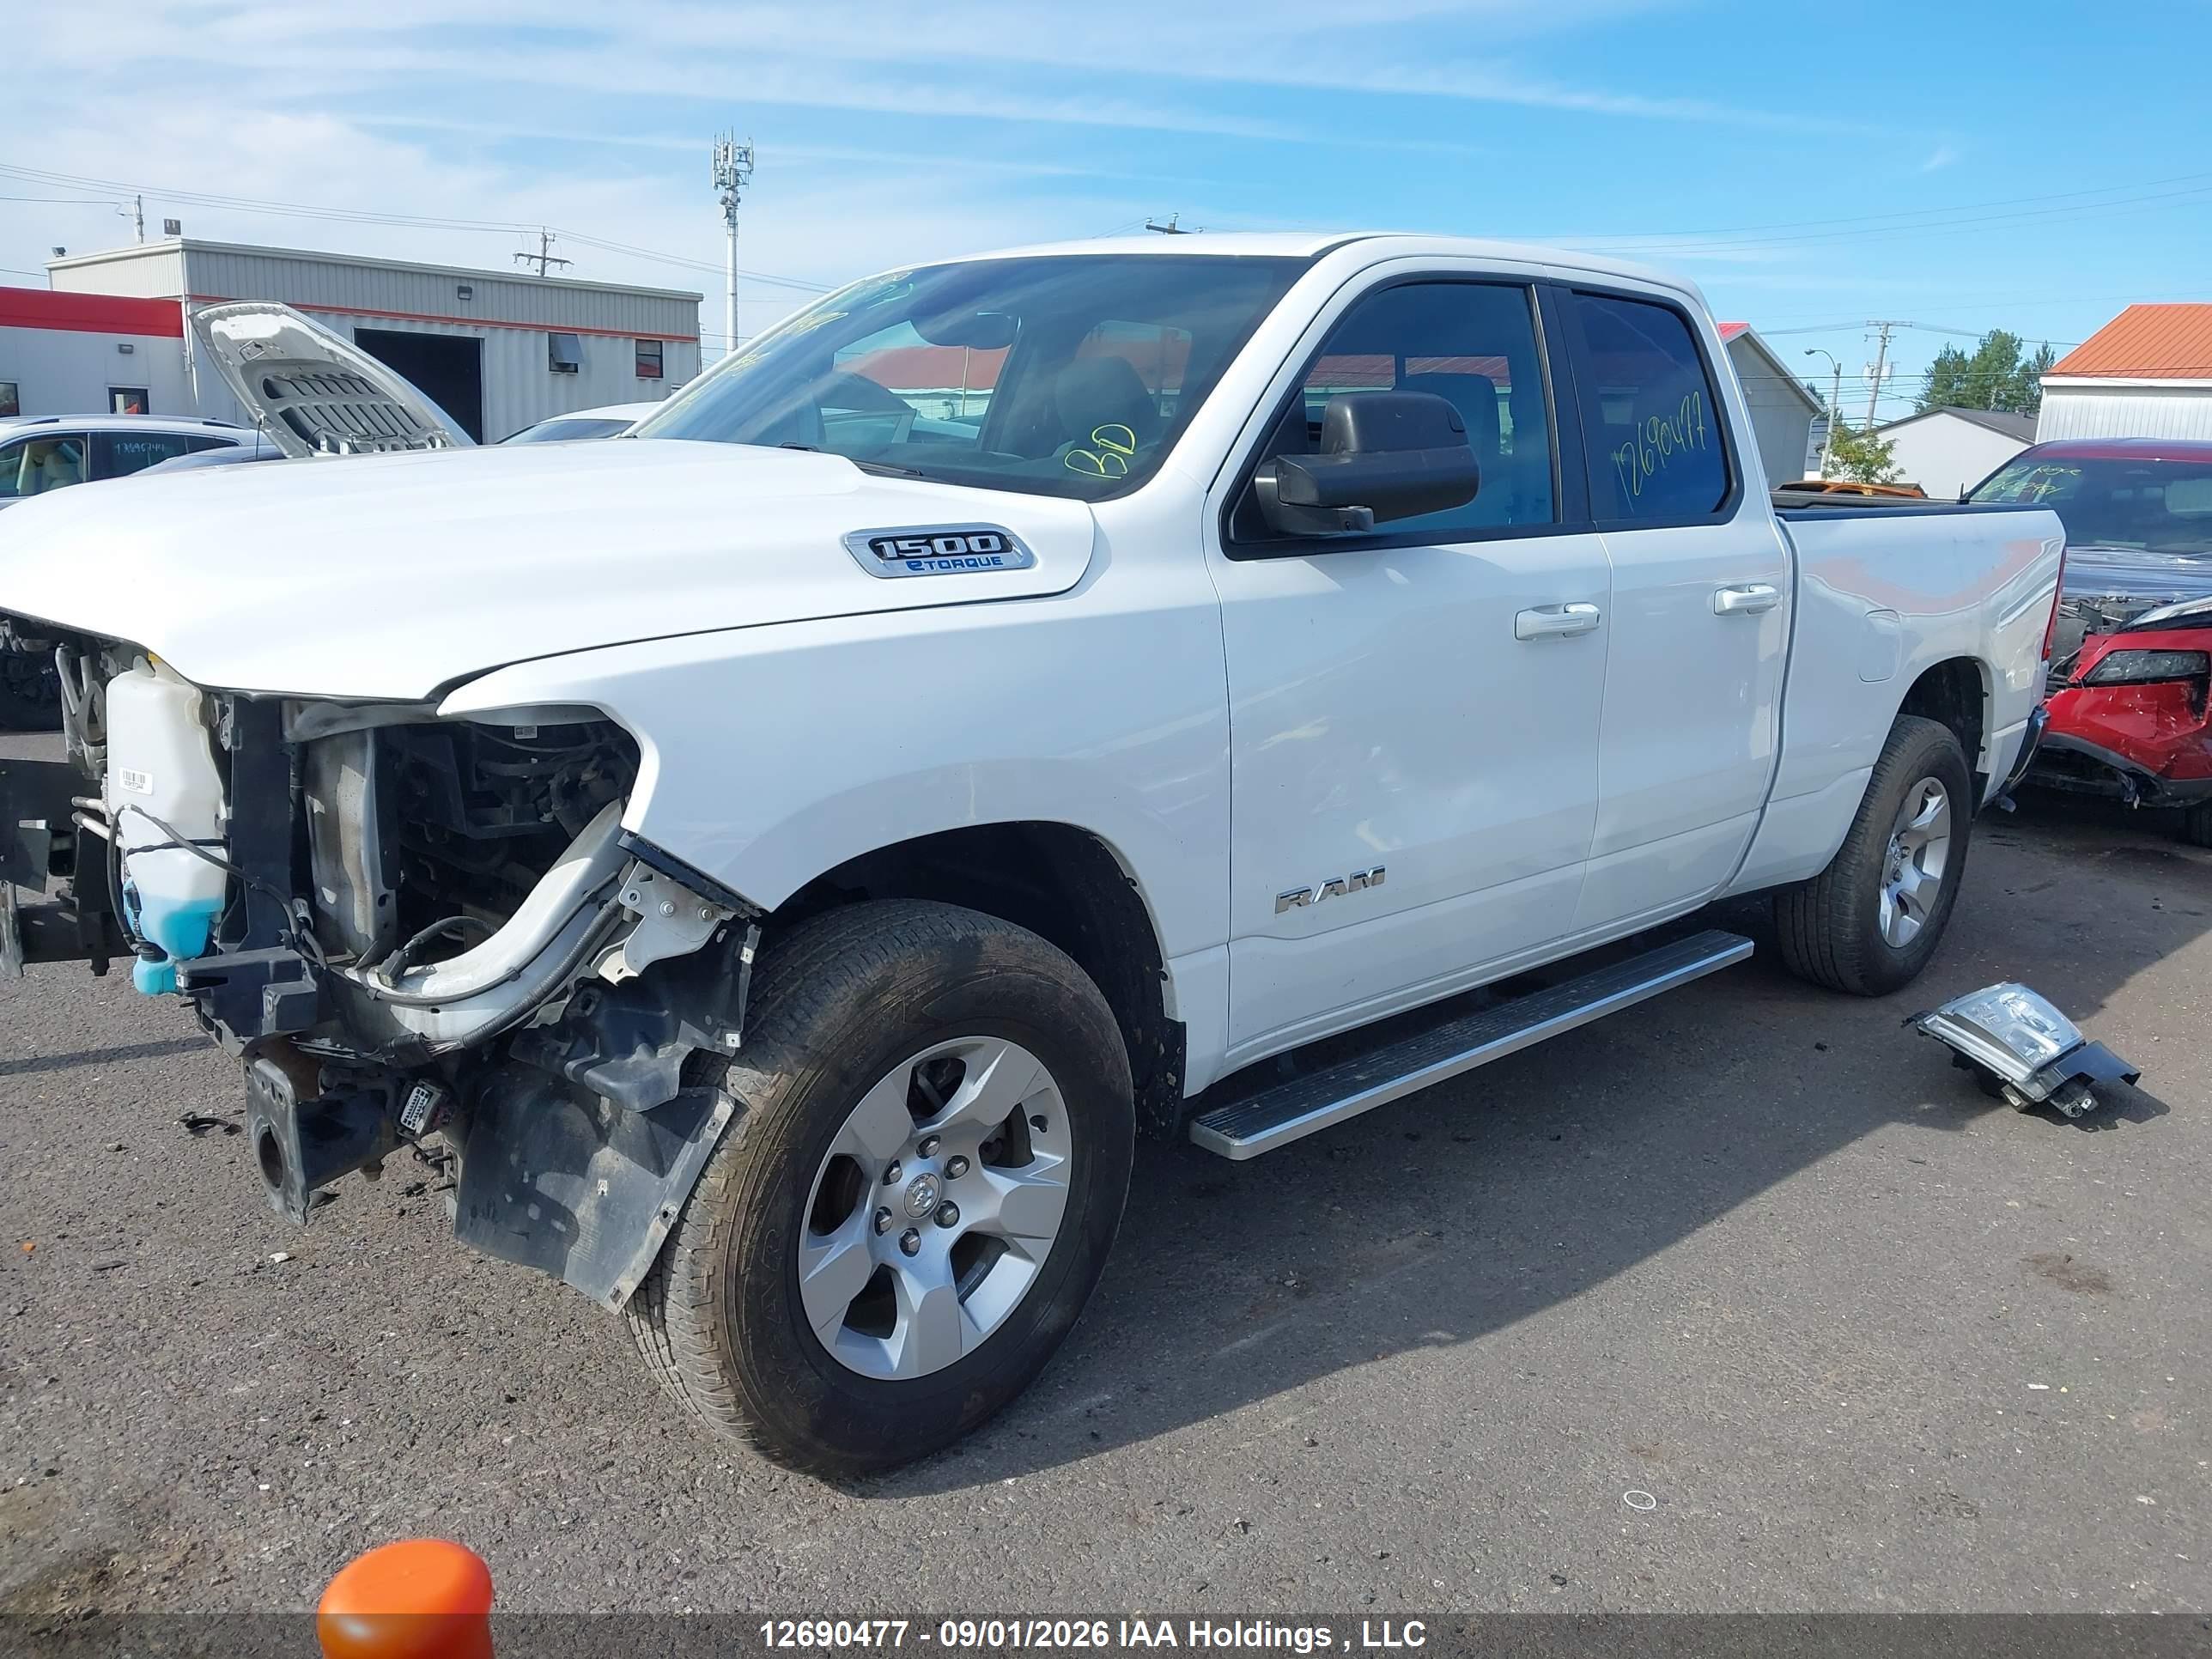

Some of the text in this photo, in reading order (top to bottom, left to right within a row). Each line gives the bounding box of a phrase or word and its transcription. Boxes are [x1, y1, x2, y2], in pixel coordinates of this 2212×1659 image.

[1064, 422, 1135, 479] BD
[1613, 391, 1706, 514] 12690477
[875, 534, 1003, 559] 1500
[1274, 864, 1386, 915] RAM
